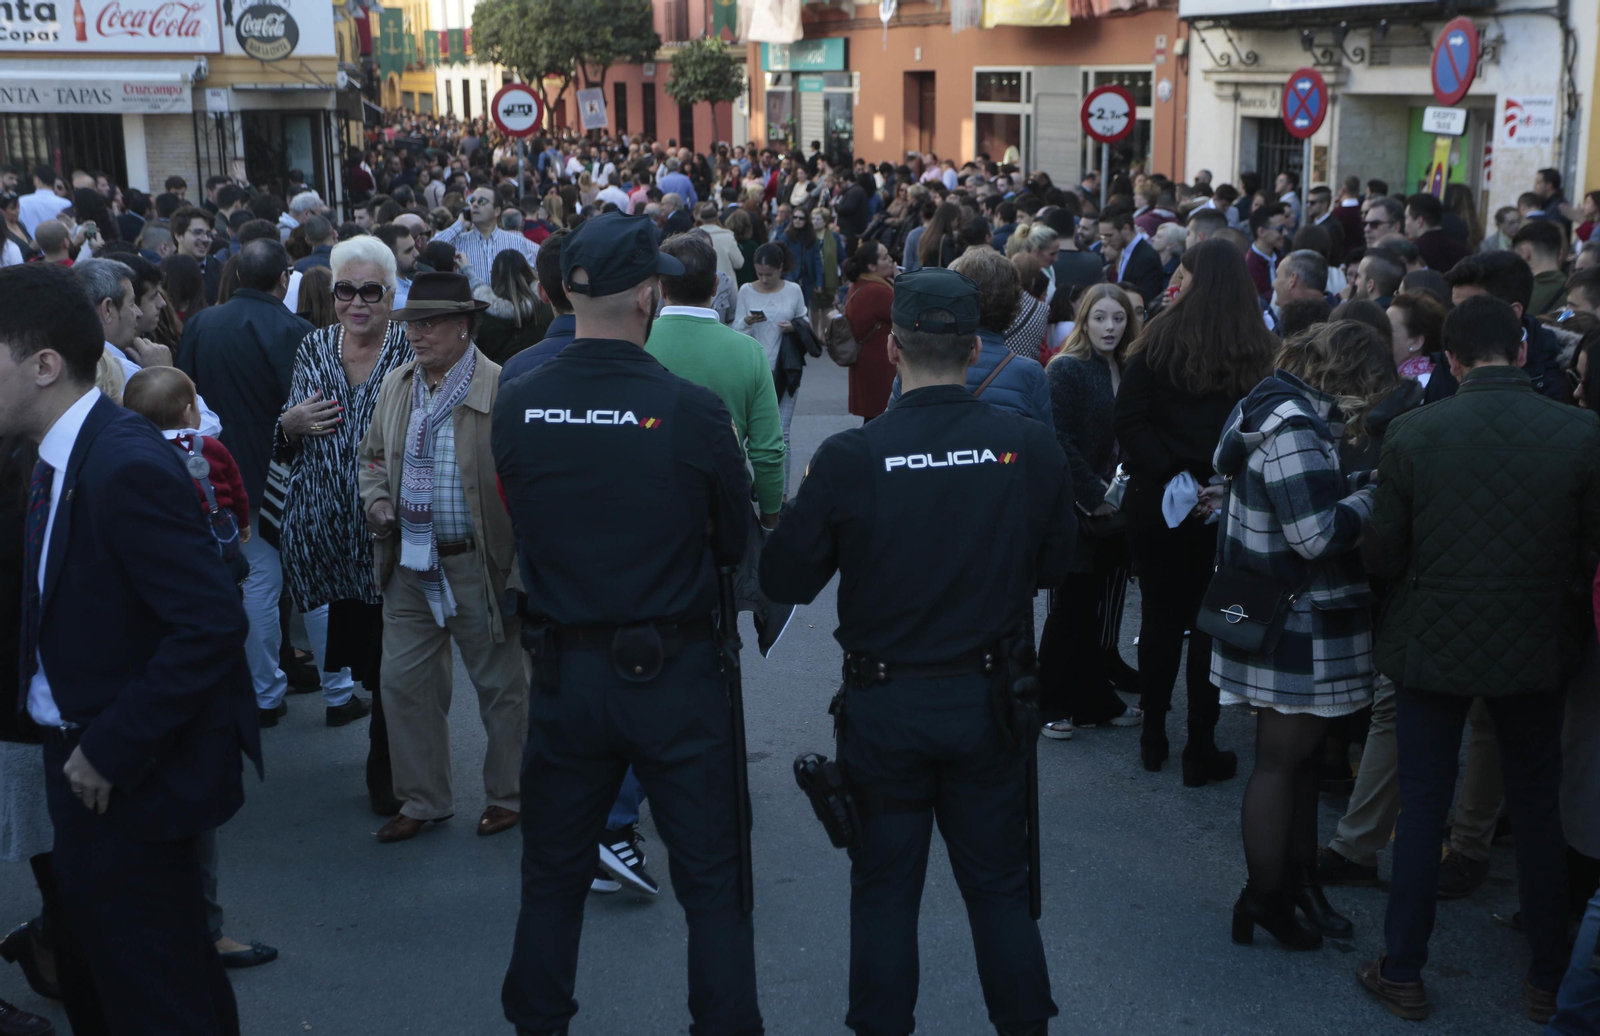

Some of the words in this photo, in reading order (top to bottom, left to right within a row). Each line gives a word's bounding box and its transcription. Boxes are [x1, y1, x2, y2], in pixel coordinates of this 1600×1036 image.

[96, 0, 204, 38] Coca-Cola
[53, 87, 112, 105] TAPAS
[123, 82, 183, 96] Cruzcampo
[524, 409, 639, 425] POLICIA
[885, 448, 998, 472] POLICIA
